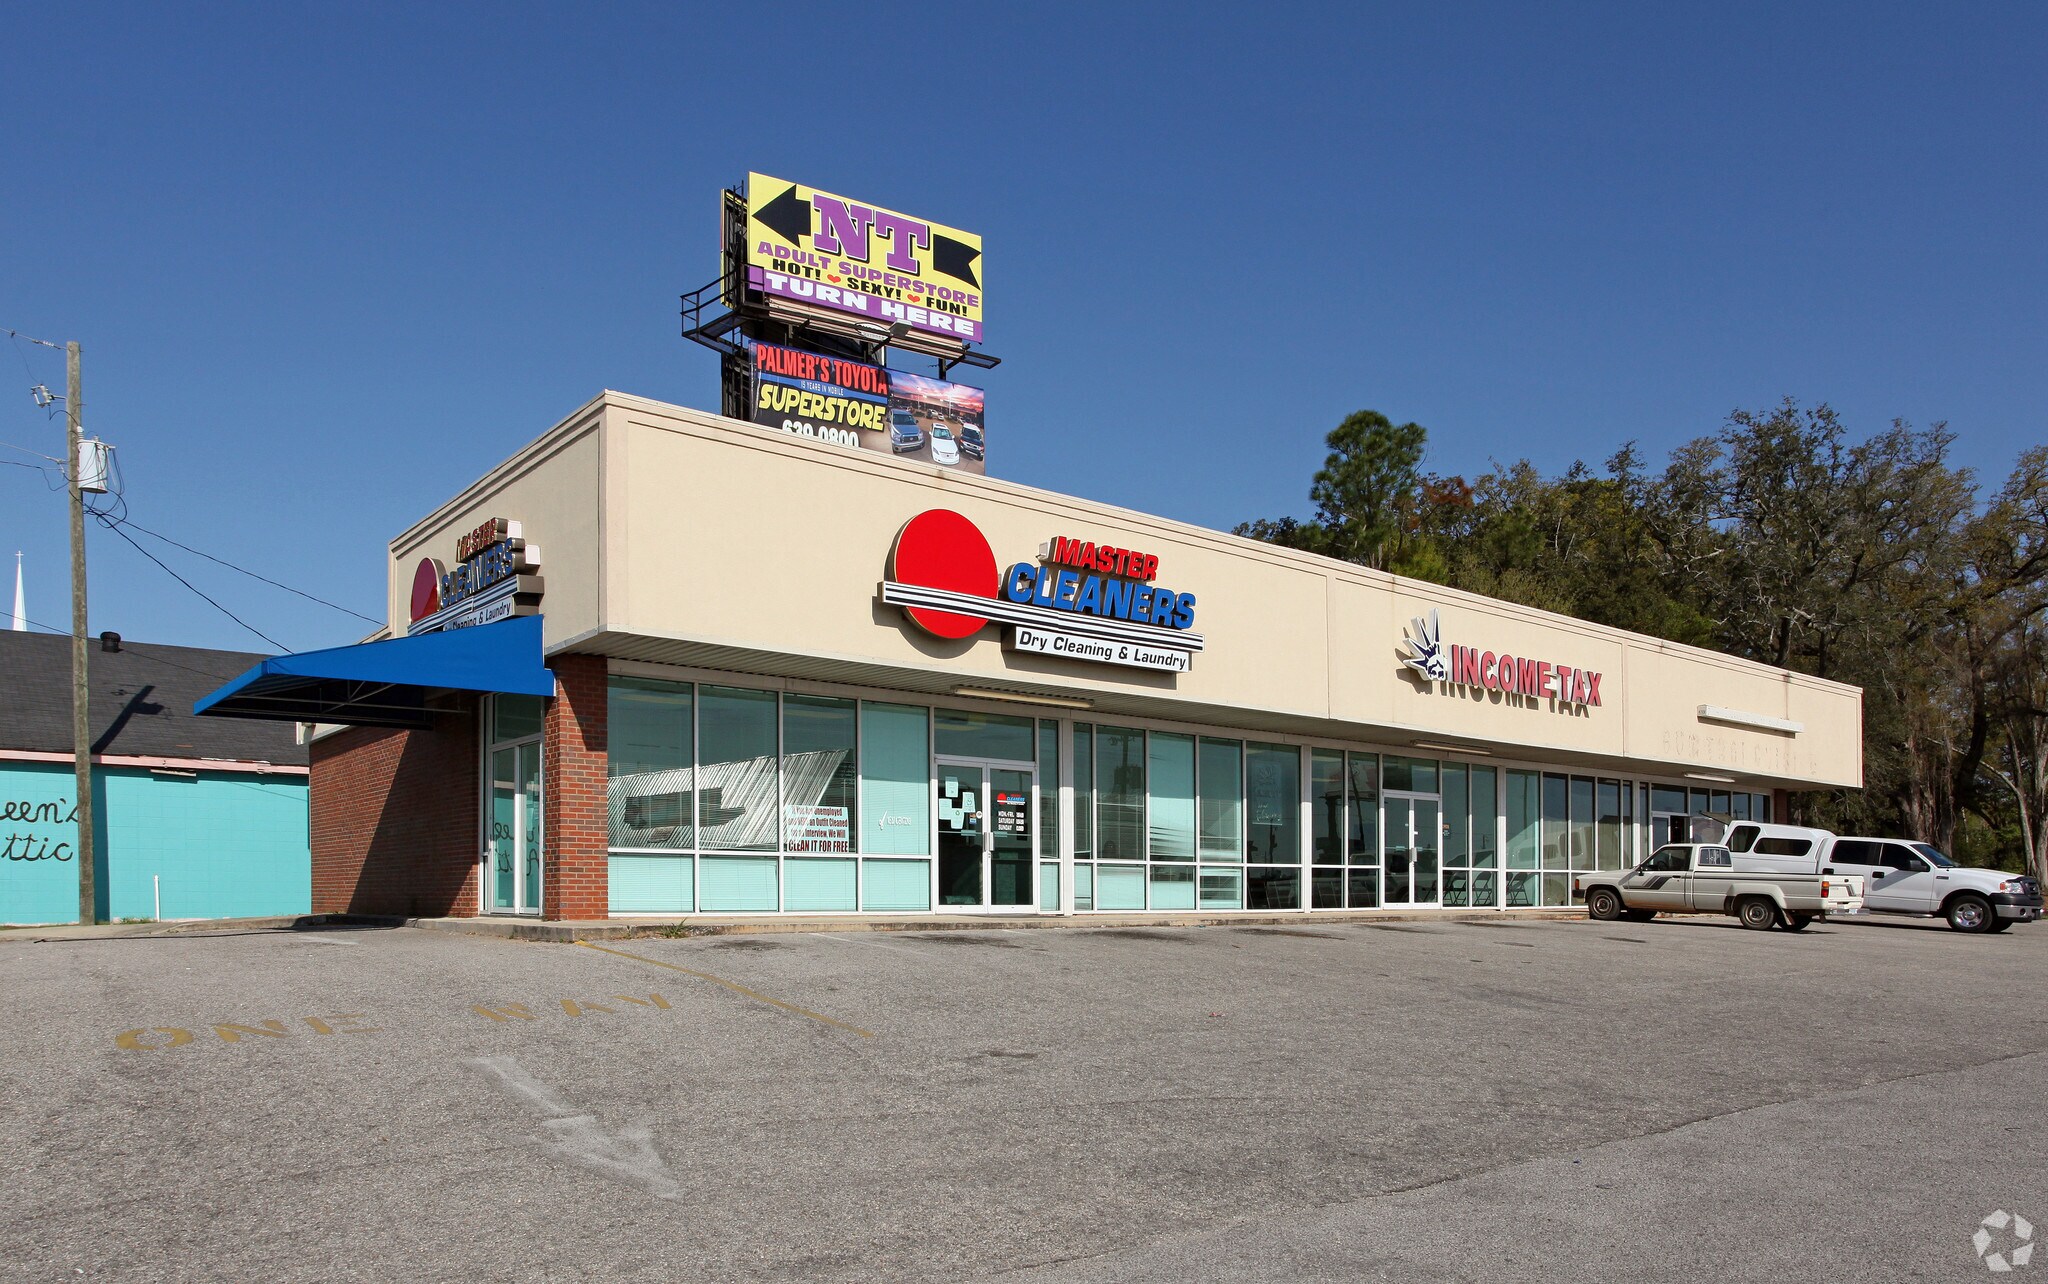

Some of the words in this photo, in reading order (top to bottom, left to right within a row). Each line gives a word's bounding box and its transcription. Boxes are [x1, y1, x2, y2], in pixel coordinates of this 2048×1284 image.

[812, 193, 929, 276] NT
[757, 241, 831, 270] ADULT
[838, 261, 979, 308] SUPERSTORE
[772, 259, 821, 281] HOT!
[847, 277, 901, 300] SEXY!
[926, 297, 968, 317] FUN!
[765, 272, 867, 311] TURN
[881, 300, 974, 337] HERE
[757, 343, 830, 383] PALMER'S
[833, 360, 888, 395] TOYOTA
[759, 383, 886, 431] SUPERSTORE
[456, 517, 498, 563] MASTER
[1053, 536, 1159, 581] MASTER
[441, 537, 515, 609] CLEANERS
[1007, 562, 1197, 630] CLEANERS
[479, 612, 484, 623] &
[486, 602, 511, 621] Laundry
[1019, 631, 1048, 650] Dry
[1053, 636, 1113, 661] Cleaning
[1118, 646, 1128, 660] &
[1134, 648, 1187, 670] Laundry
[1452, 644, 1552, 698] INCOME
[1557, 665, 1602, 707] TAX
[789, 840, 810, 852] CLEAN
[811, 840, 818, 852] IT
[819, 841, 832, 852] FOR
[833, 841, 849, 853] FREE
[115, 1010, 385, 1051] ONE
